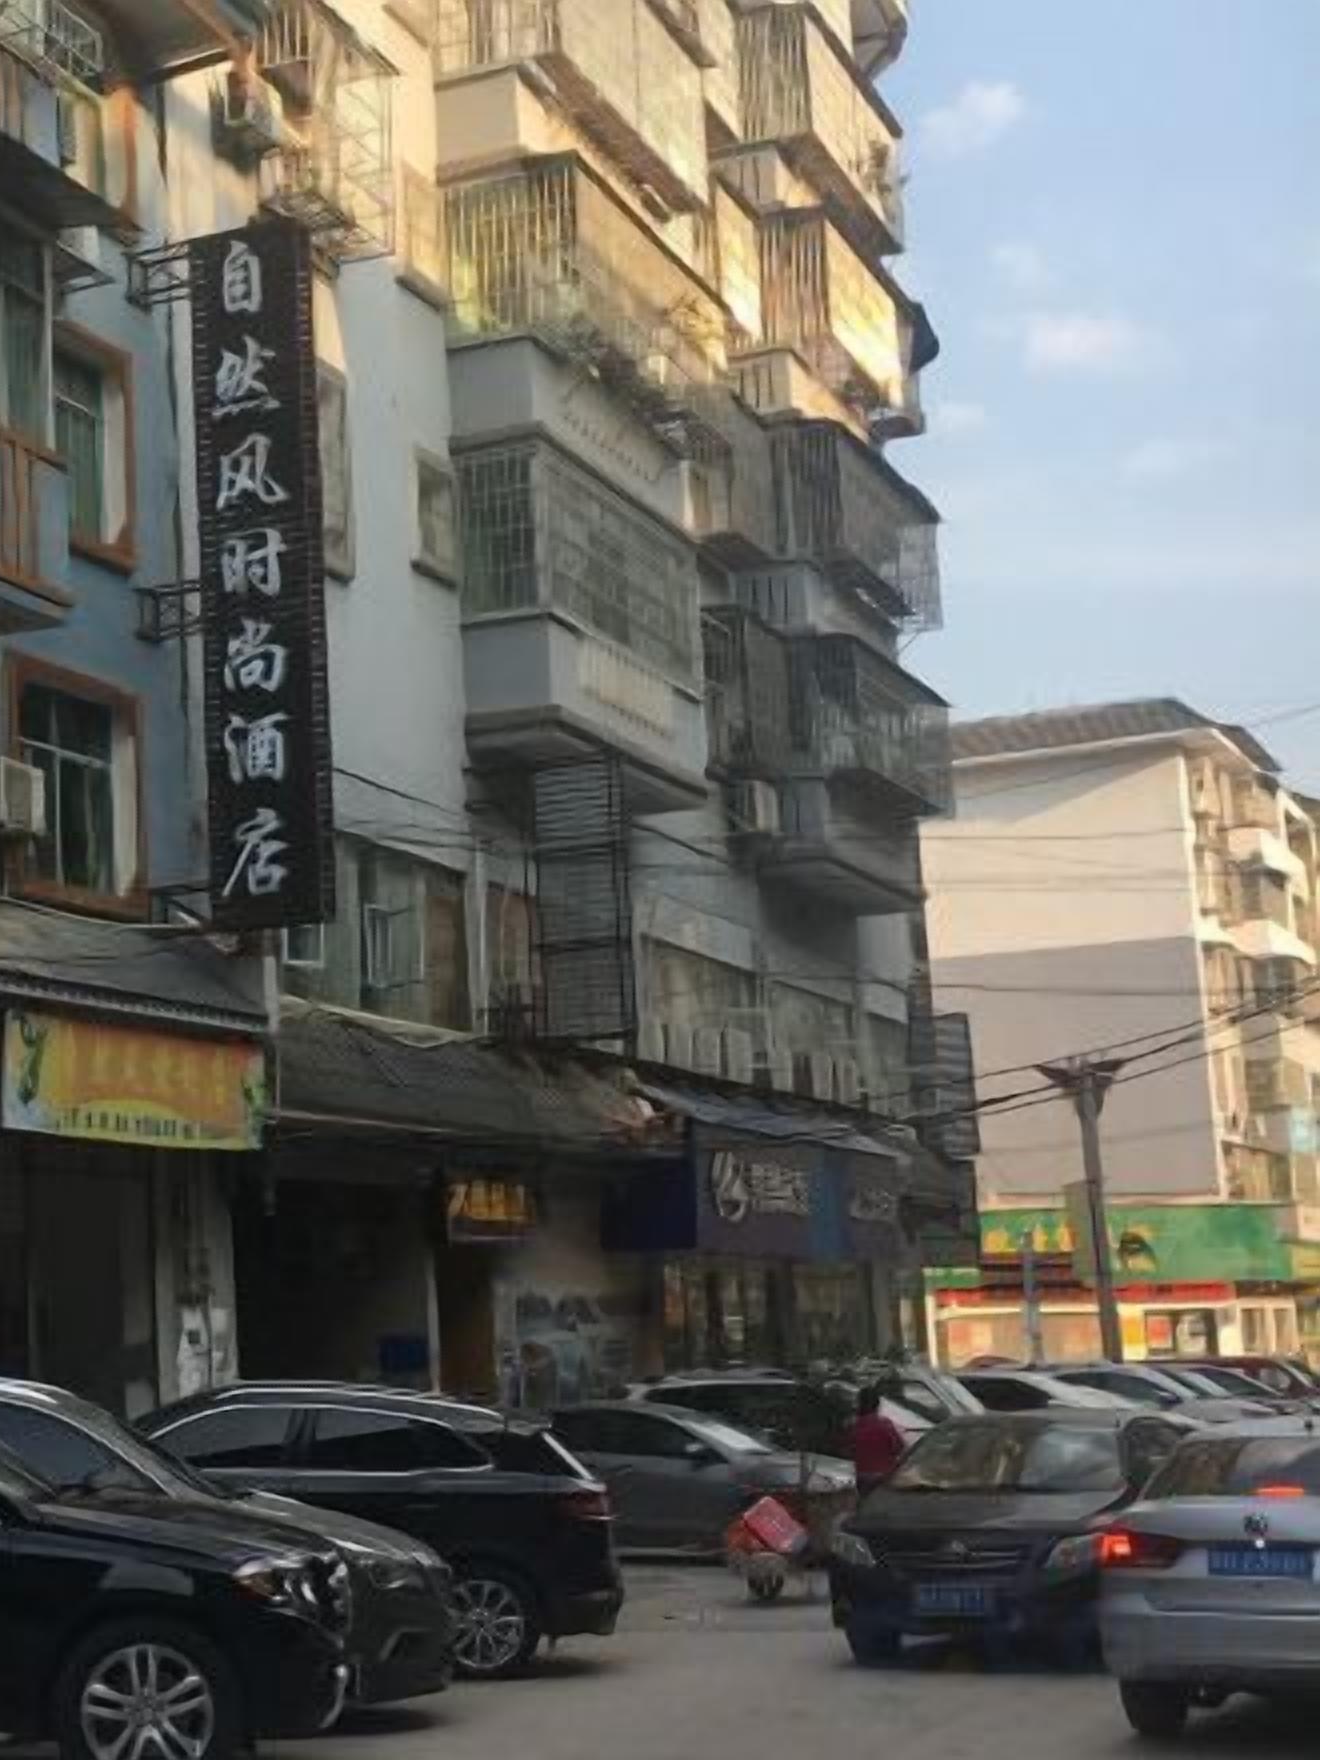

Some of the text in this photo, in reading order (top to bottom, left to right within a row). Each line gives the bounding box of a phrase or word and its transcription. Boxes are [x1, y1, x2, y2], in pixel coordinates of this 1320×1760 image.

[212, 240, 289, 898] 自然风时尚酒店
